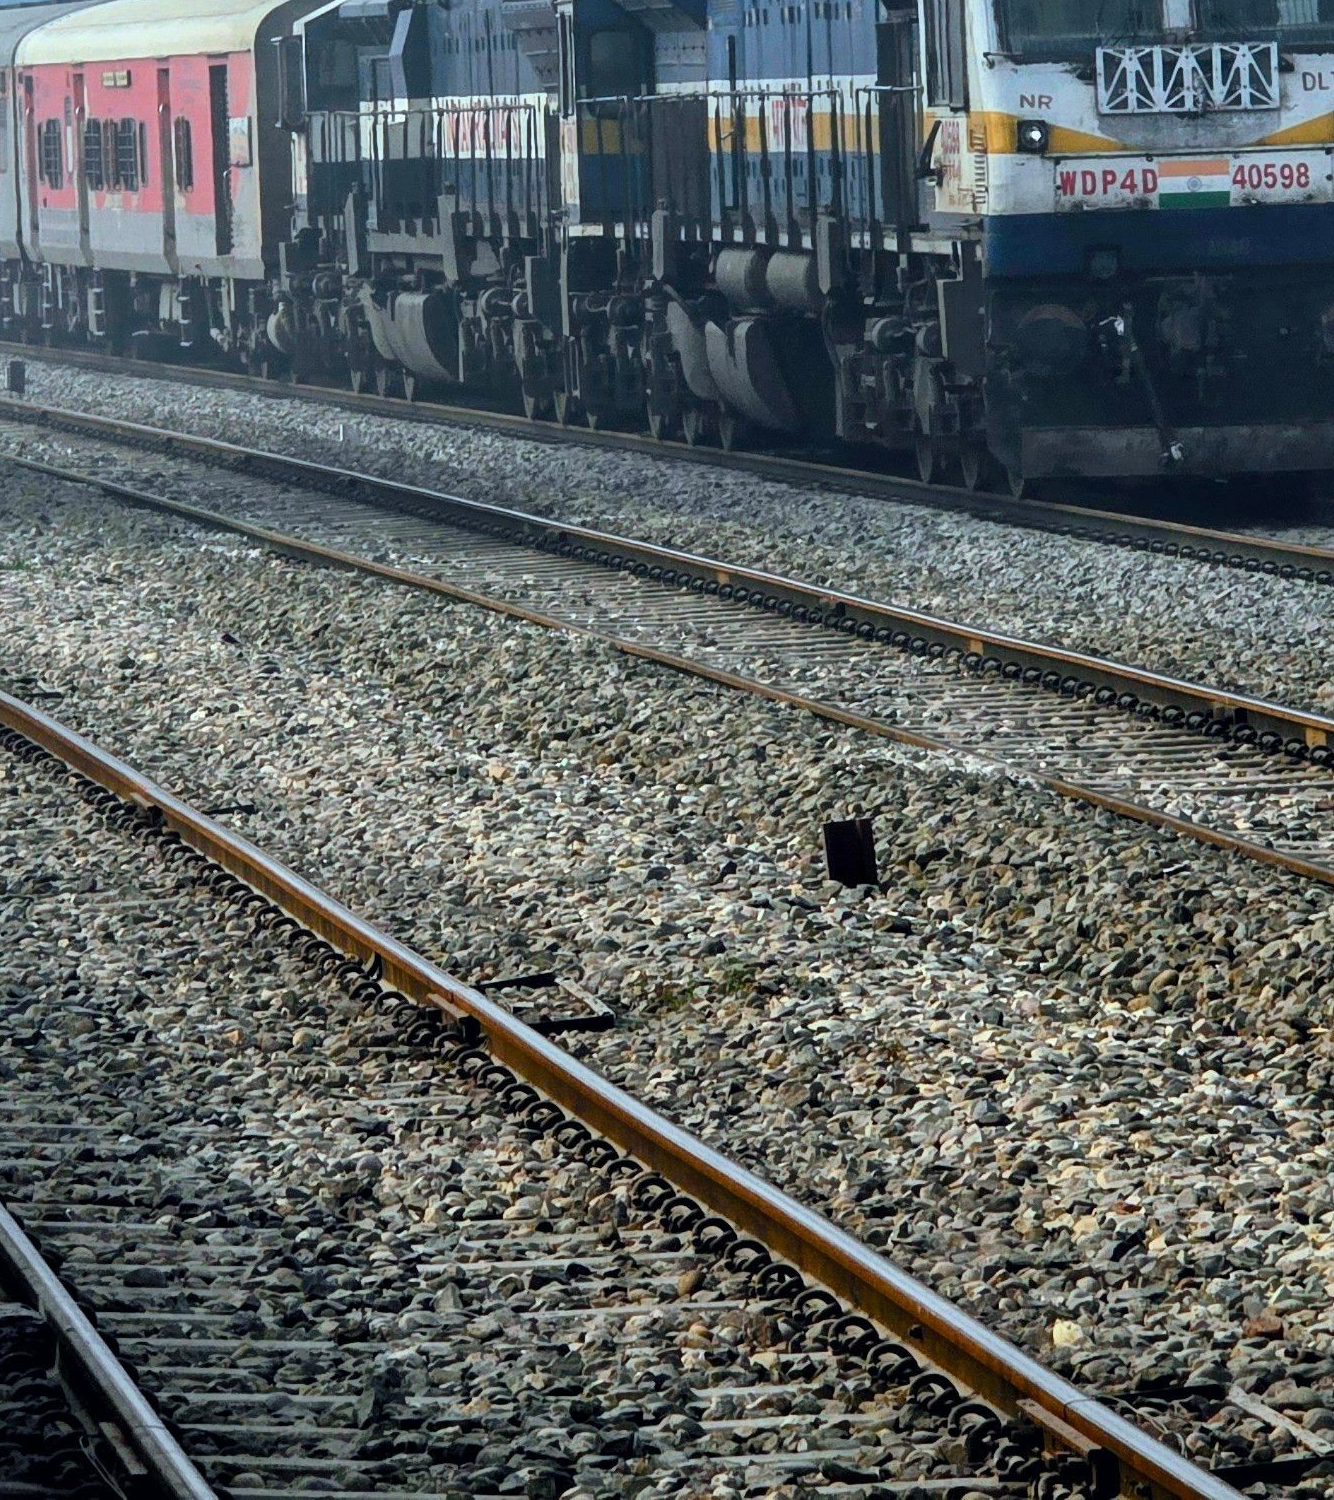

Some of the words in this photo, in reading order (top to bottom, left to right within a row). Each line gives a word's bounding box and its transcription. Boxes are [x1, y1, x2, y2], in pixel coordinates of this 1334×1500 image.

[1019, 94, 1053, 109] NR
[1059, 167, 1158, 196] WDP4D
[1232, 162, 1310, 190] 40598
